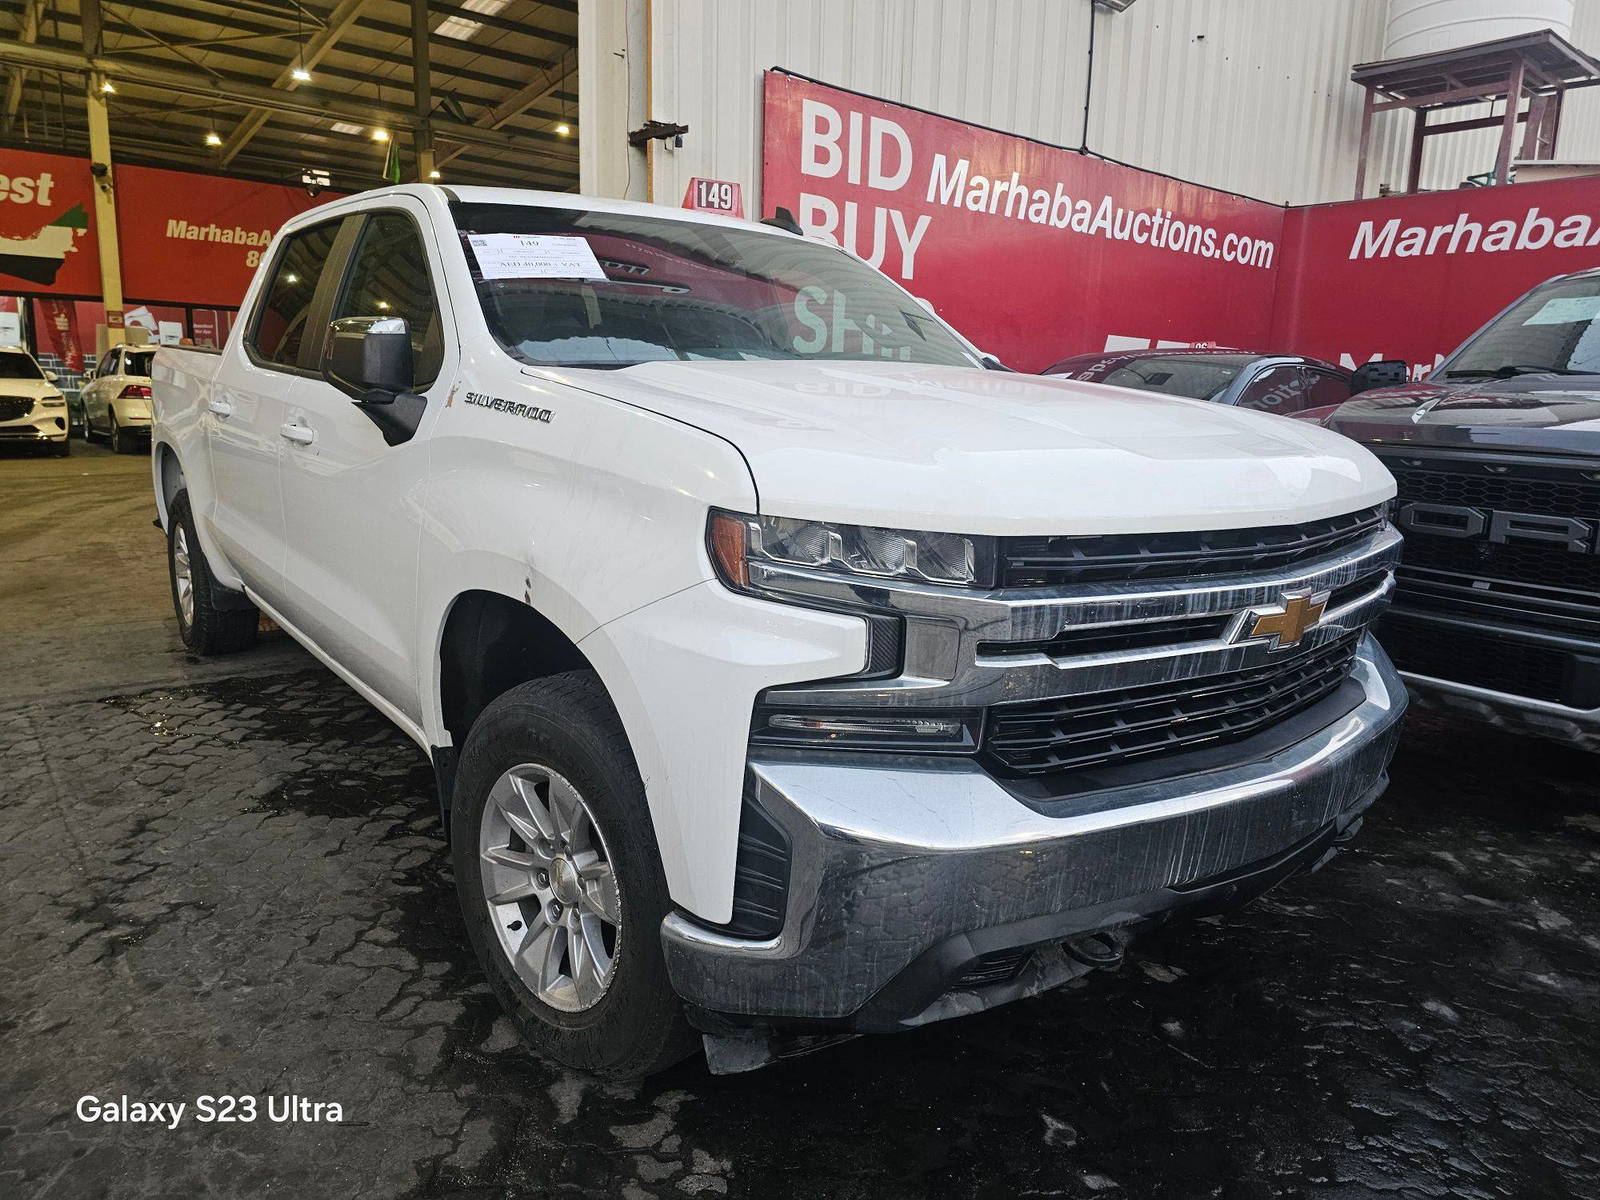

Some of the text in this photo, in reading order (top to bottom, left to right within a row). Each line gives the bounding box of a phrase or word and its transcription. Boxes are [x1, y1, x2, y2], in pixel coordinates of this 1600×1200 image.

[801, 98, 913, 192] BID
[698, 181, 732, 210] 149
[926, 153, 1275, 269] MarhabaAuctions.com
[166, 219, 276, 247] MarhabaA
[800, 192, 932, 280] BUY
[246, 250, 266, 268] 8
[464, 392, 553, 423] SILVERADO
